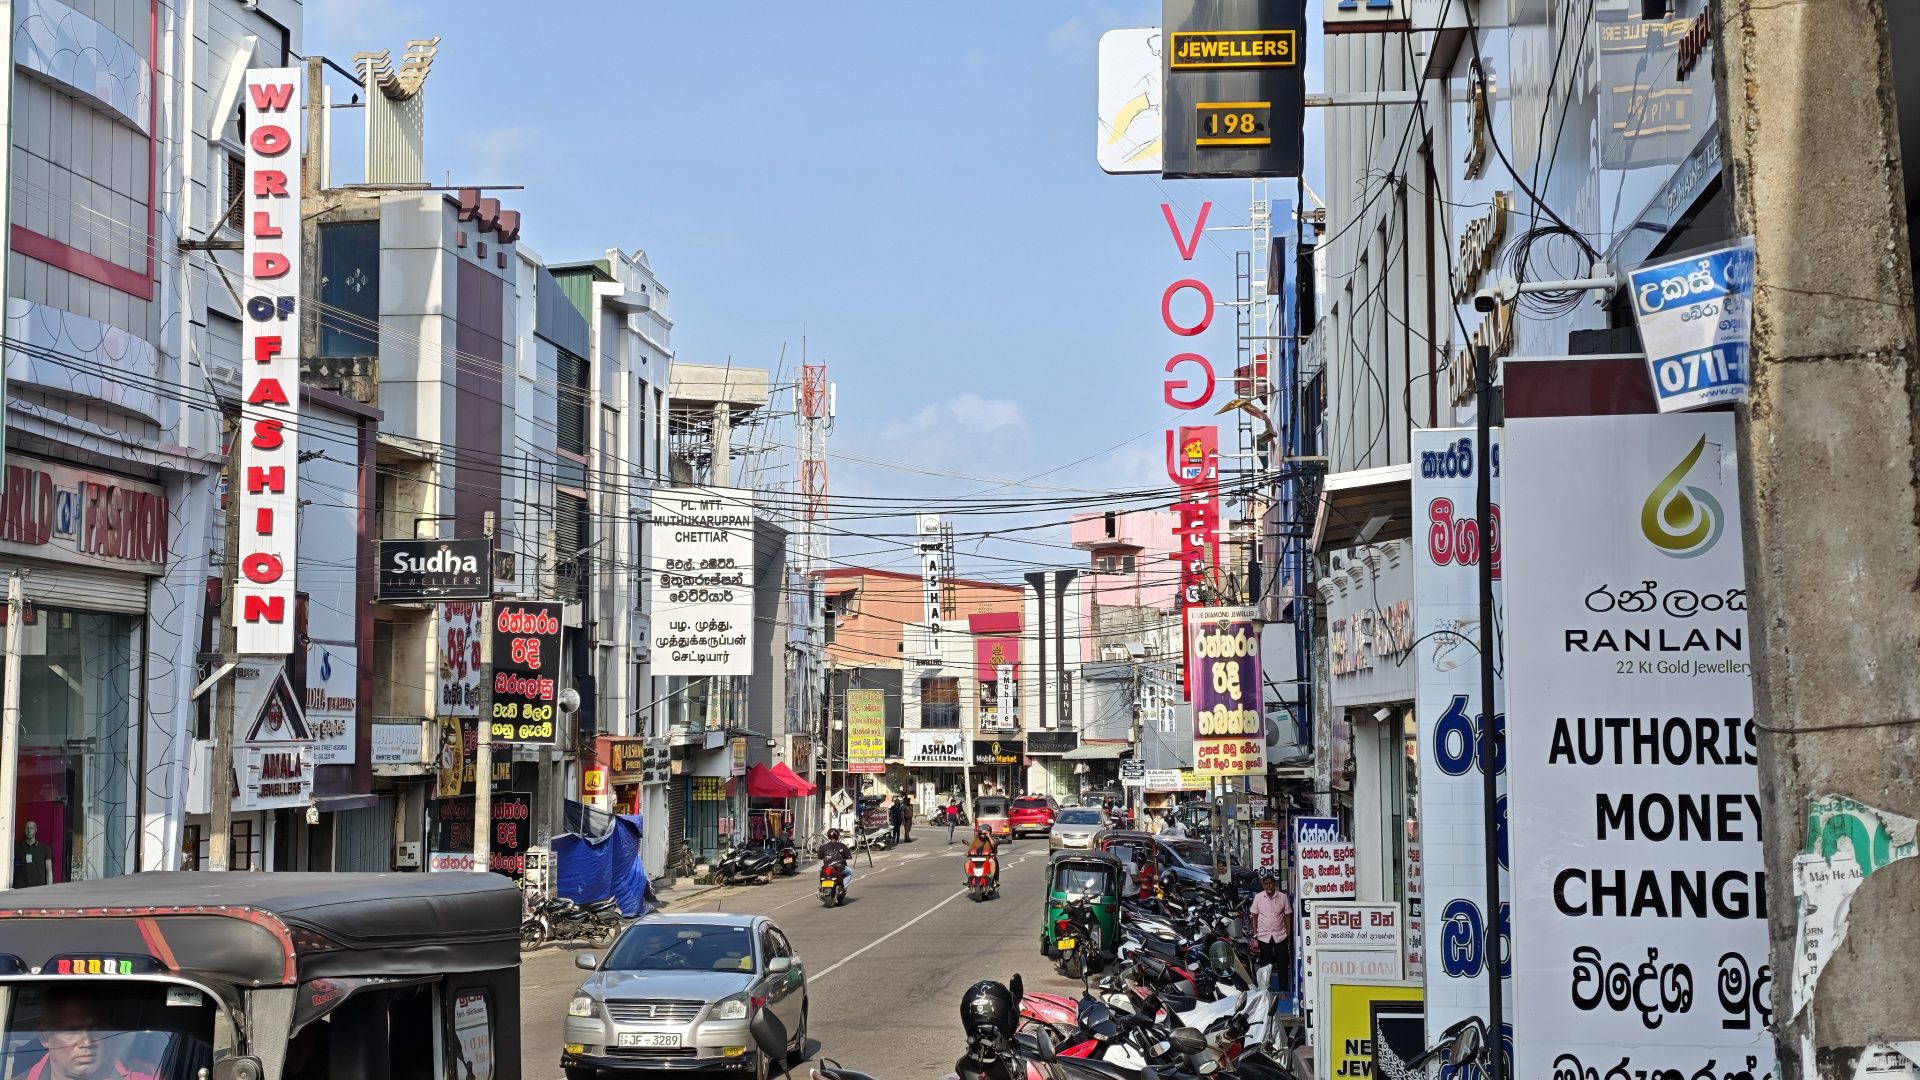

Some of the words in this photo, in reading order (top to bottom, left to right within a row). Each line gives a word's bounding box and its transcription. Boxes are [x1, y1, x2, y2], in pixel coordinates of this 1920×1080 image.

[1178, 40, 1289, 58] JEWELLERS
[1677, 5, 1712, 81] AUTH
[1212, 113, 1255, 134] 198
[248, 83, 294, 280] WORLD
[1640, 260, 1715, 313] උකස්
[247, 296, 295, 322] OF
[1660, 344, 1750, 393] 0711-
[242, 335, 290, 624] FASHION
[1186, 467, 1215, 479] NE
[681, 501, 697, 511] PL.
[700, 500, 723, 511] MTT.
[0, 465, 52, 545] RLD
[80, 481, 169, 564] FASHION
[654, 516, 750, 527] MUTHUKARUPPAN
[675, 531, 728, 542] CHETTIAR
[392, 551, 478, 576] Sudha
[388, 577, 481, 586] JEWELLERS
[929, 560, 940, 650] ASHADI
[669, 620, 691, 632] பழ.
[695, 620, 733, 632] முத்து.
[656, 634, 746, 648] முத்துக்கருப்பன்
[1565, 628, 1742, 652] RANLAN
[672, 651, 730, 664] செட்டியார்
[1616, 661, 1634, 673] 22
[1639, 661, 1653, 673] Kt
[1657, 660, 1689, 674] Gold
[1692, 660, 1752, 677] Jewellery
[922, 745, 956, 754] ASHADI
[263, 753, 301, 778] AMALA
[976, 755, 995, 763] Mobile
[996, 755, 1017, 763] Market
[493, 763, 510, 780] LINE
[259, 782, 301, 798] JEWELLERS
[1809, 871, 1830, 884] May
[1833, 870, 1845, 880] He
[1807, 938, 1819, 948] 82
[1322, 962, 1355, 975] GOLD
[1360, 961, 1394, 975] LOAN
[1572, 945, 1693, 1030] විදේශ
[629, 1036, 642, 1046] JF
[652, 1036, 678, 1046] 3289
[1345, 1039, 1372, 1055] NE
